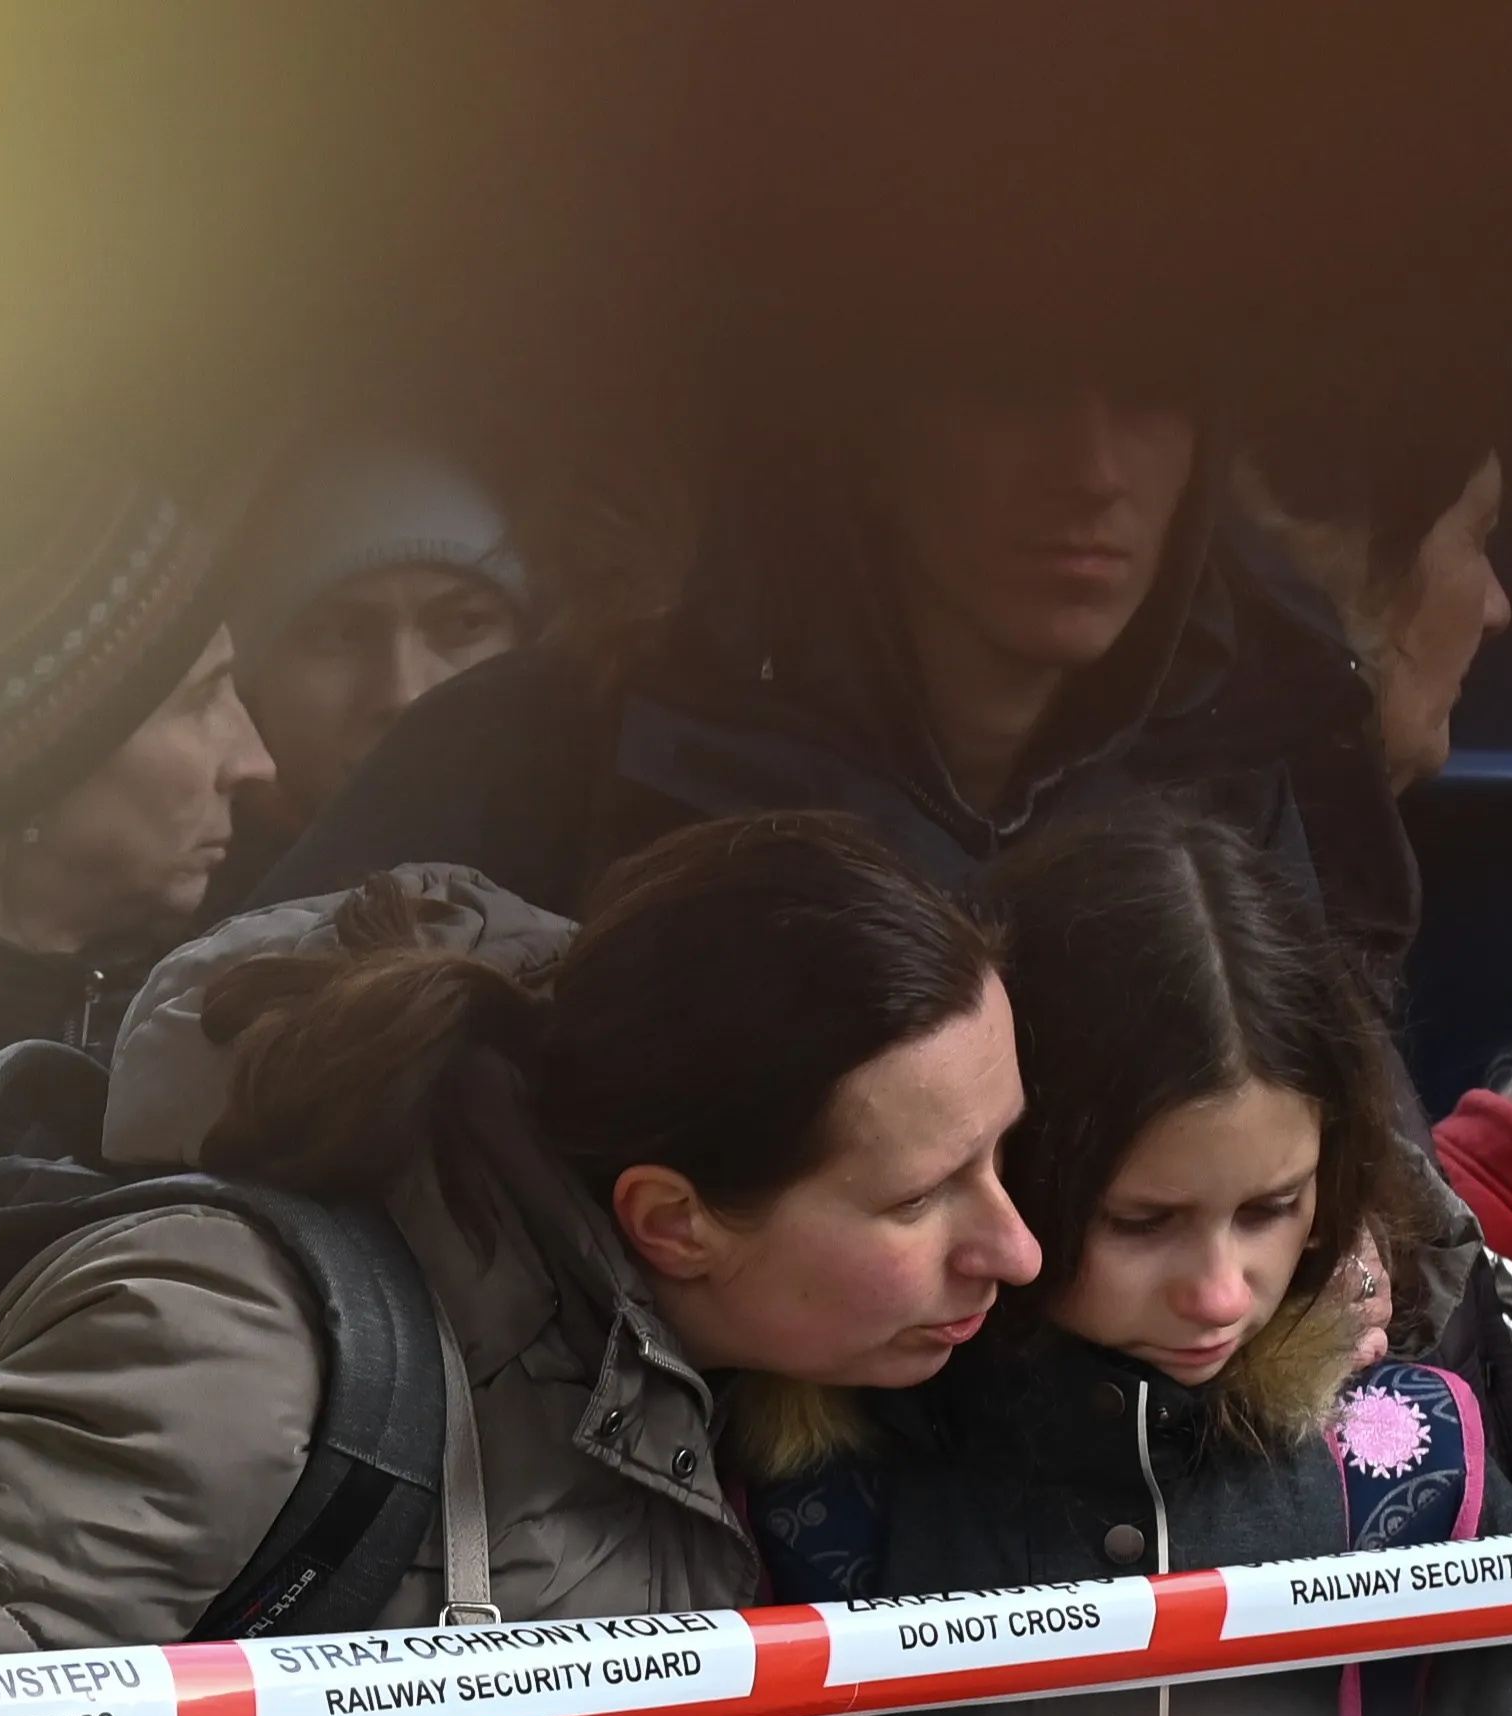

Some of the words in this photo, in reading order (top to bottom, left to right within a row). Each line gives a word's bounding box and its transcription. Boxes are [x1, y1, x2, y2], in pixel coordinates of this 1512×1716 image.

[1290, 1567, 1401, 1606] RAILWAY
[270, 1635, 403, 1673] STRAŻ
[403, 1622, 592, 1659] OCHRONY
[594, 1612, 719, 1640] KOLEI
[898, 1622, 939, 1650] DO
[945, 1614, 998, 1645] NOT
[1008, 1603, 1101, 1638] CROSS
[325, 1677, 447, 1716] RAILWAY
[456, 1661, 592, 1702] SECURITY
[602, 1650, 701, 1685] GUARD
